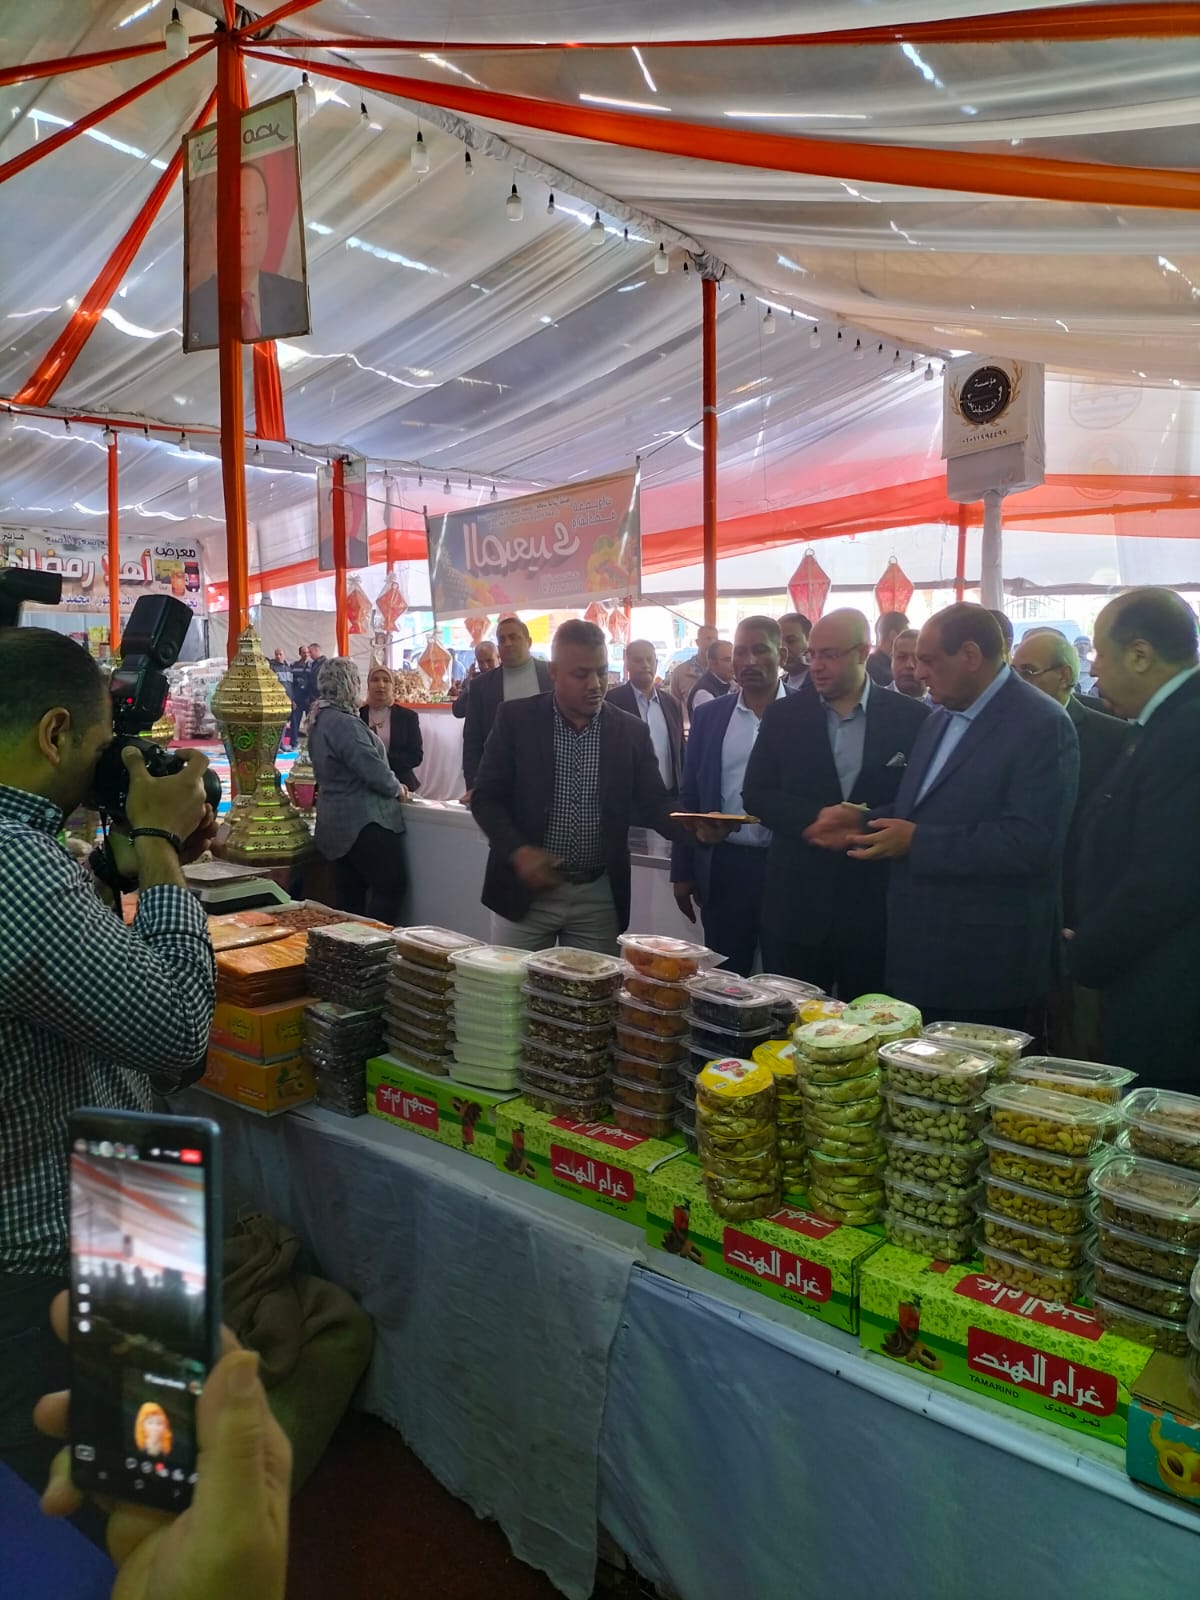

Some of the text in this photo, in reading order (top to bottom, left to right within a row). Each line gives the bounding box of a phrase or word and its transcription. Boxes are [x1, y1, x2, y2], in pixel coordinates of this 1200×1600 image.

[155, 543, 196, 560] معرض
[379, 1087, 401, 1113] غرام
[402, 1096, 435, 1118] الهند
[554, 1160, 629, 1198] غرام الهند
[725, 1267, 763, 1288] TAMARIND
[727, 1249, 823, 1297] غرام الهند
[804, 1300, 822, 1313] تمر
[968, 1373, 1020, 1399] TAMARIND
[972, 1353, 1106, 1409] غرام الهند
[1043, 1402, 1102, 1430] تمر هندى
